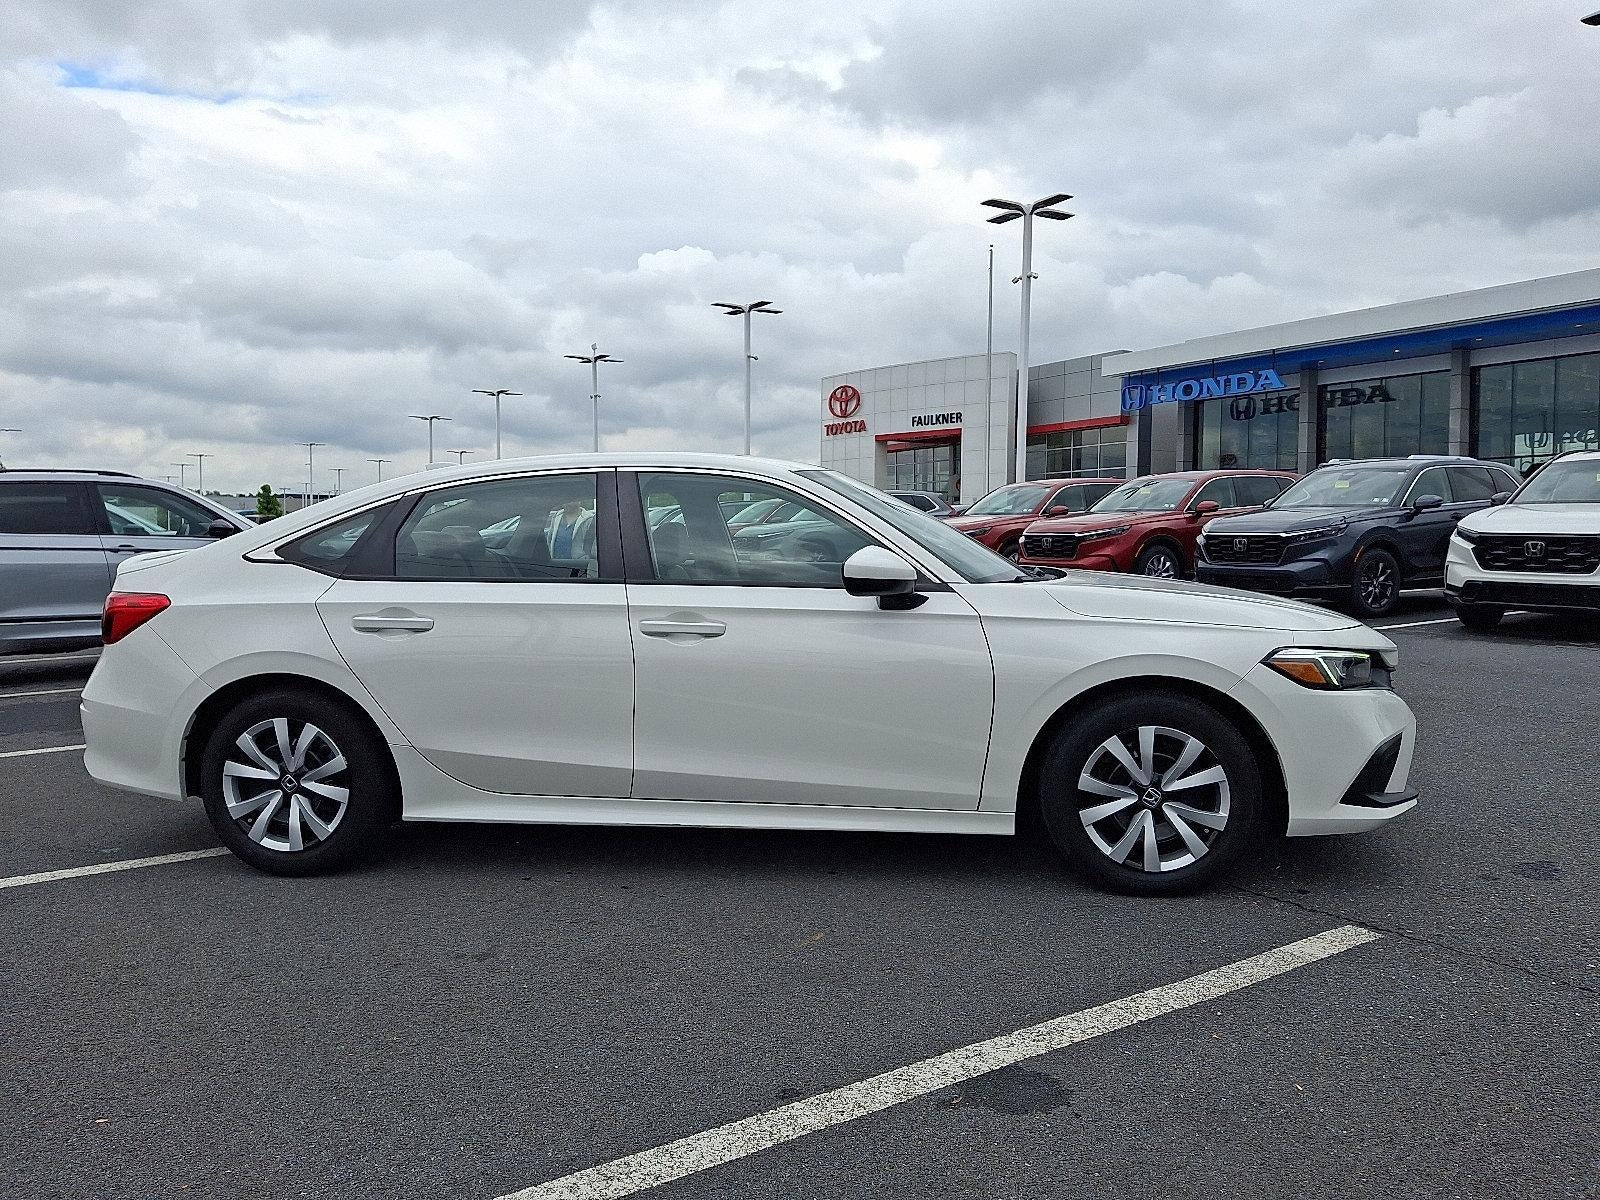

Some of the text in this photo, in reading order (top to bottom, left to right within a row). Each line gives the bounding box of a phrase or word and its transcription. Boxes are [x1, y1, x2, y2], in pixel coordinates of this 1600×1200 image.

[1149, 369, 1286, 405] HONDA
[911, 411, 963, 427] FAULKNER
[824, 420, 867, 436] TOYOTA
